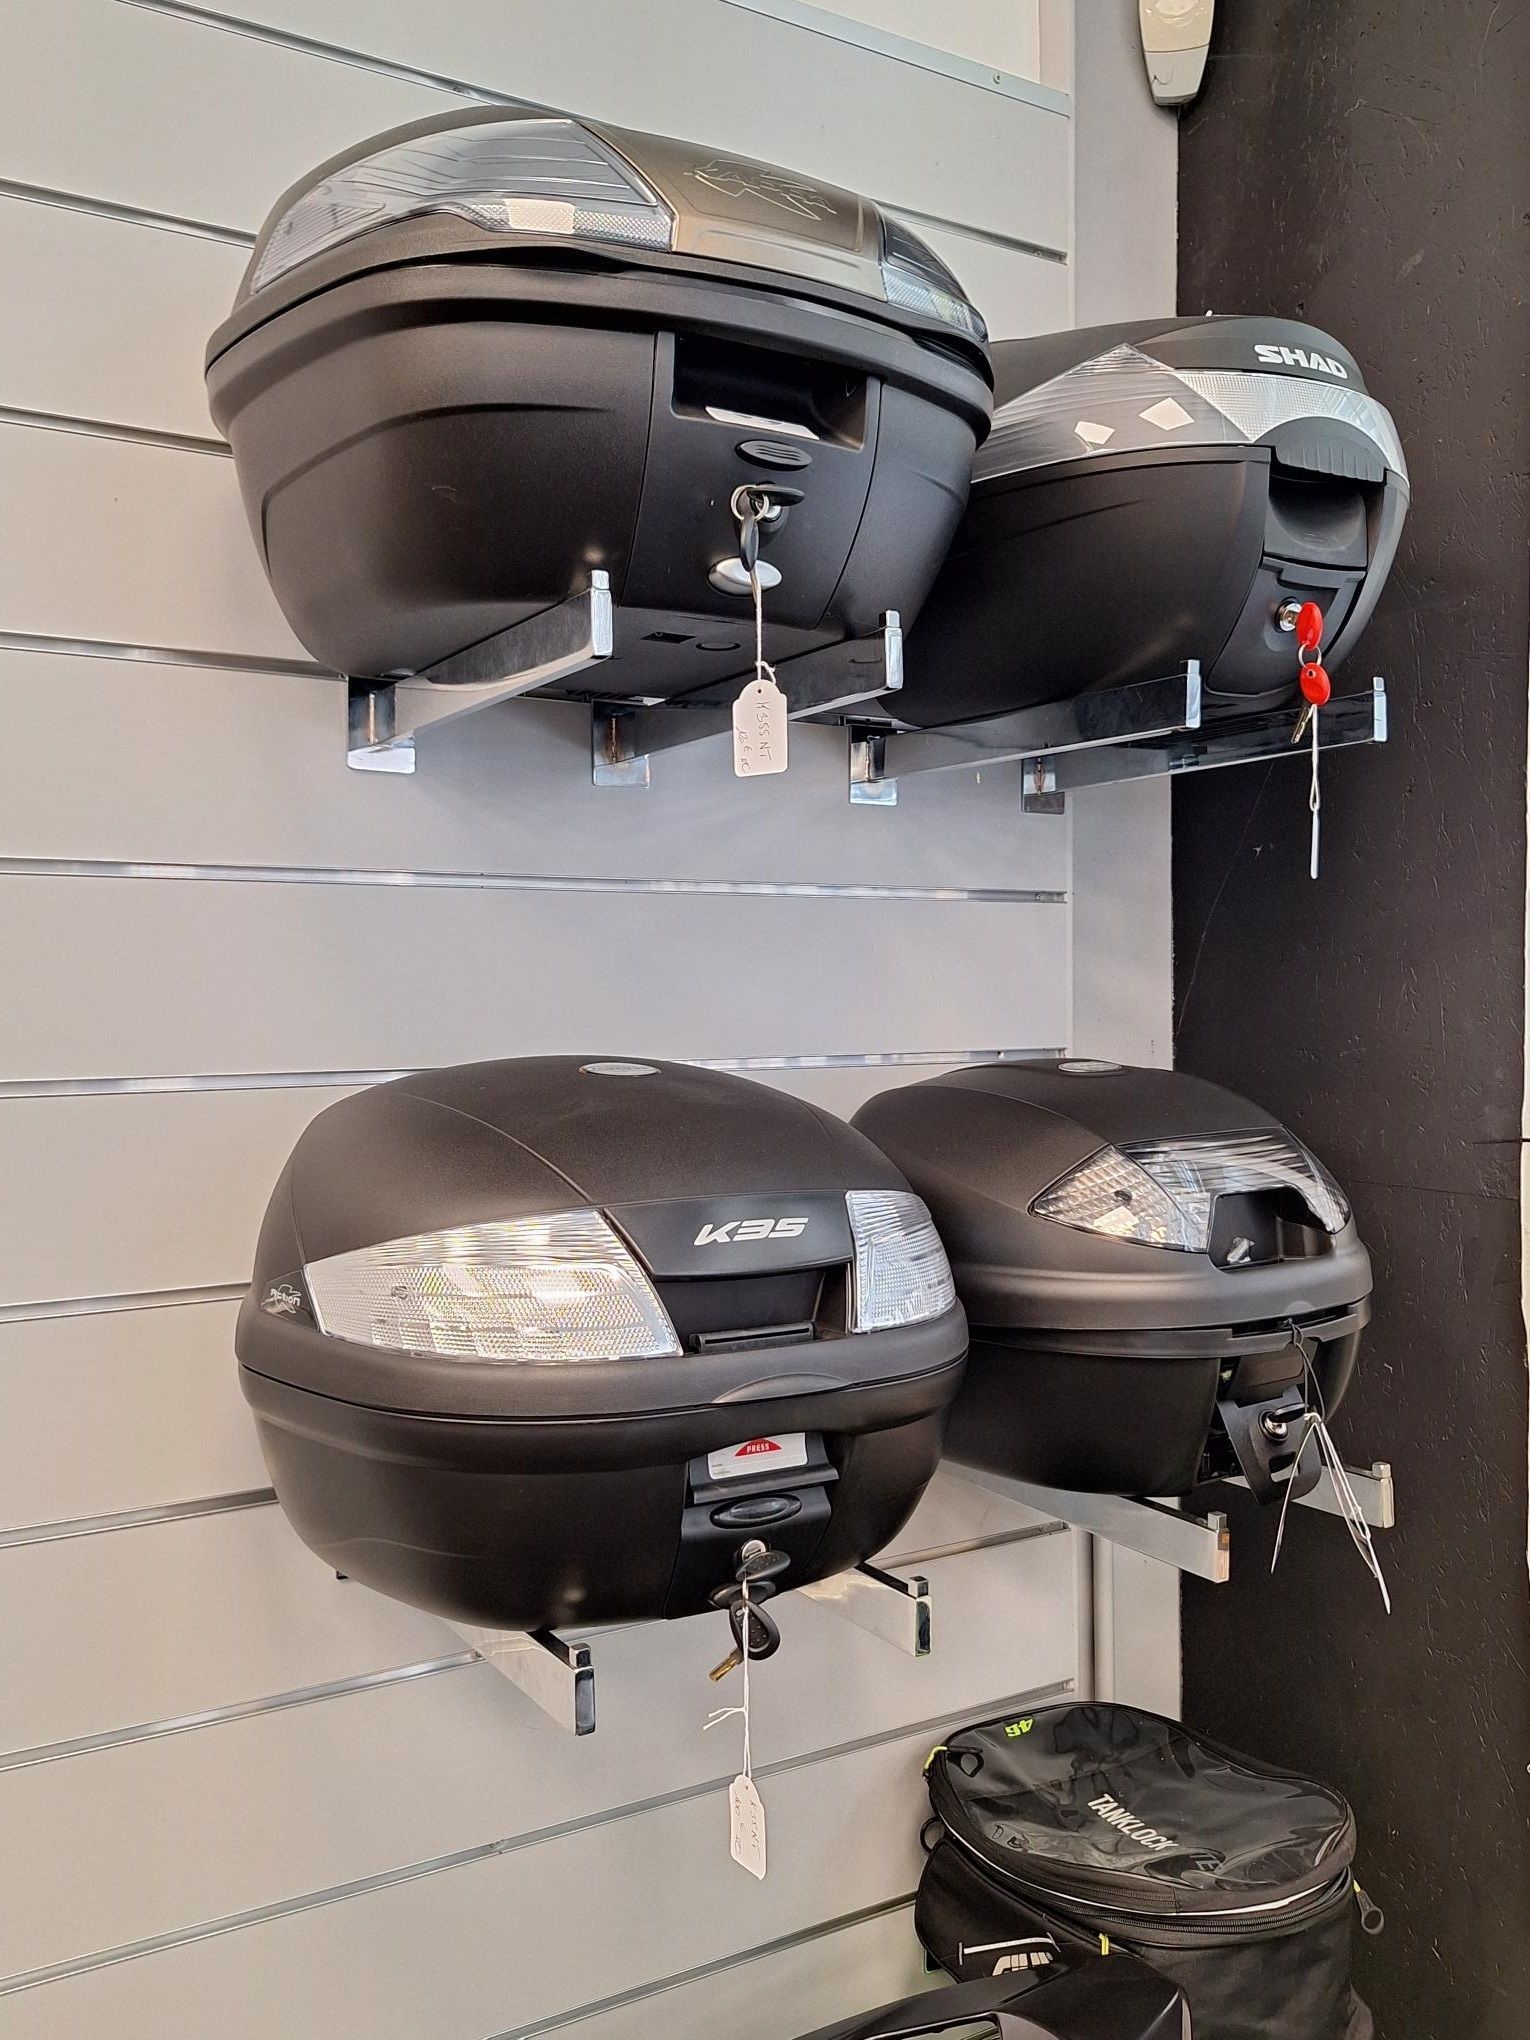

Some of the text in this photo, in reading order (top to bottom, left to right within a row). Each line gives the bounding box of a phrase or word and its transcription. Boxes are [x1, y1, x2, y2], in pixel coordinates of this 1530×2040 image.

[1253, 344, 1348, 379] SHAD
[694, 1217, 809, 1246] K35
[746, 1442, 770, 1453] PRESS
[1086, 1793, 1179, 1851] TANKLOCK
